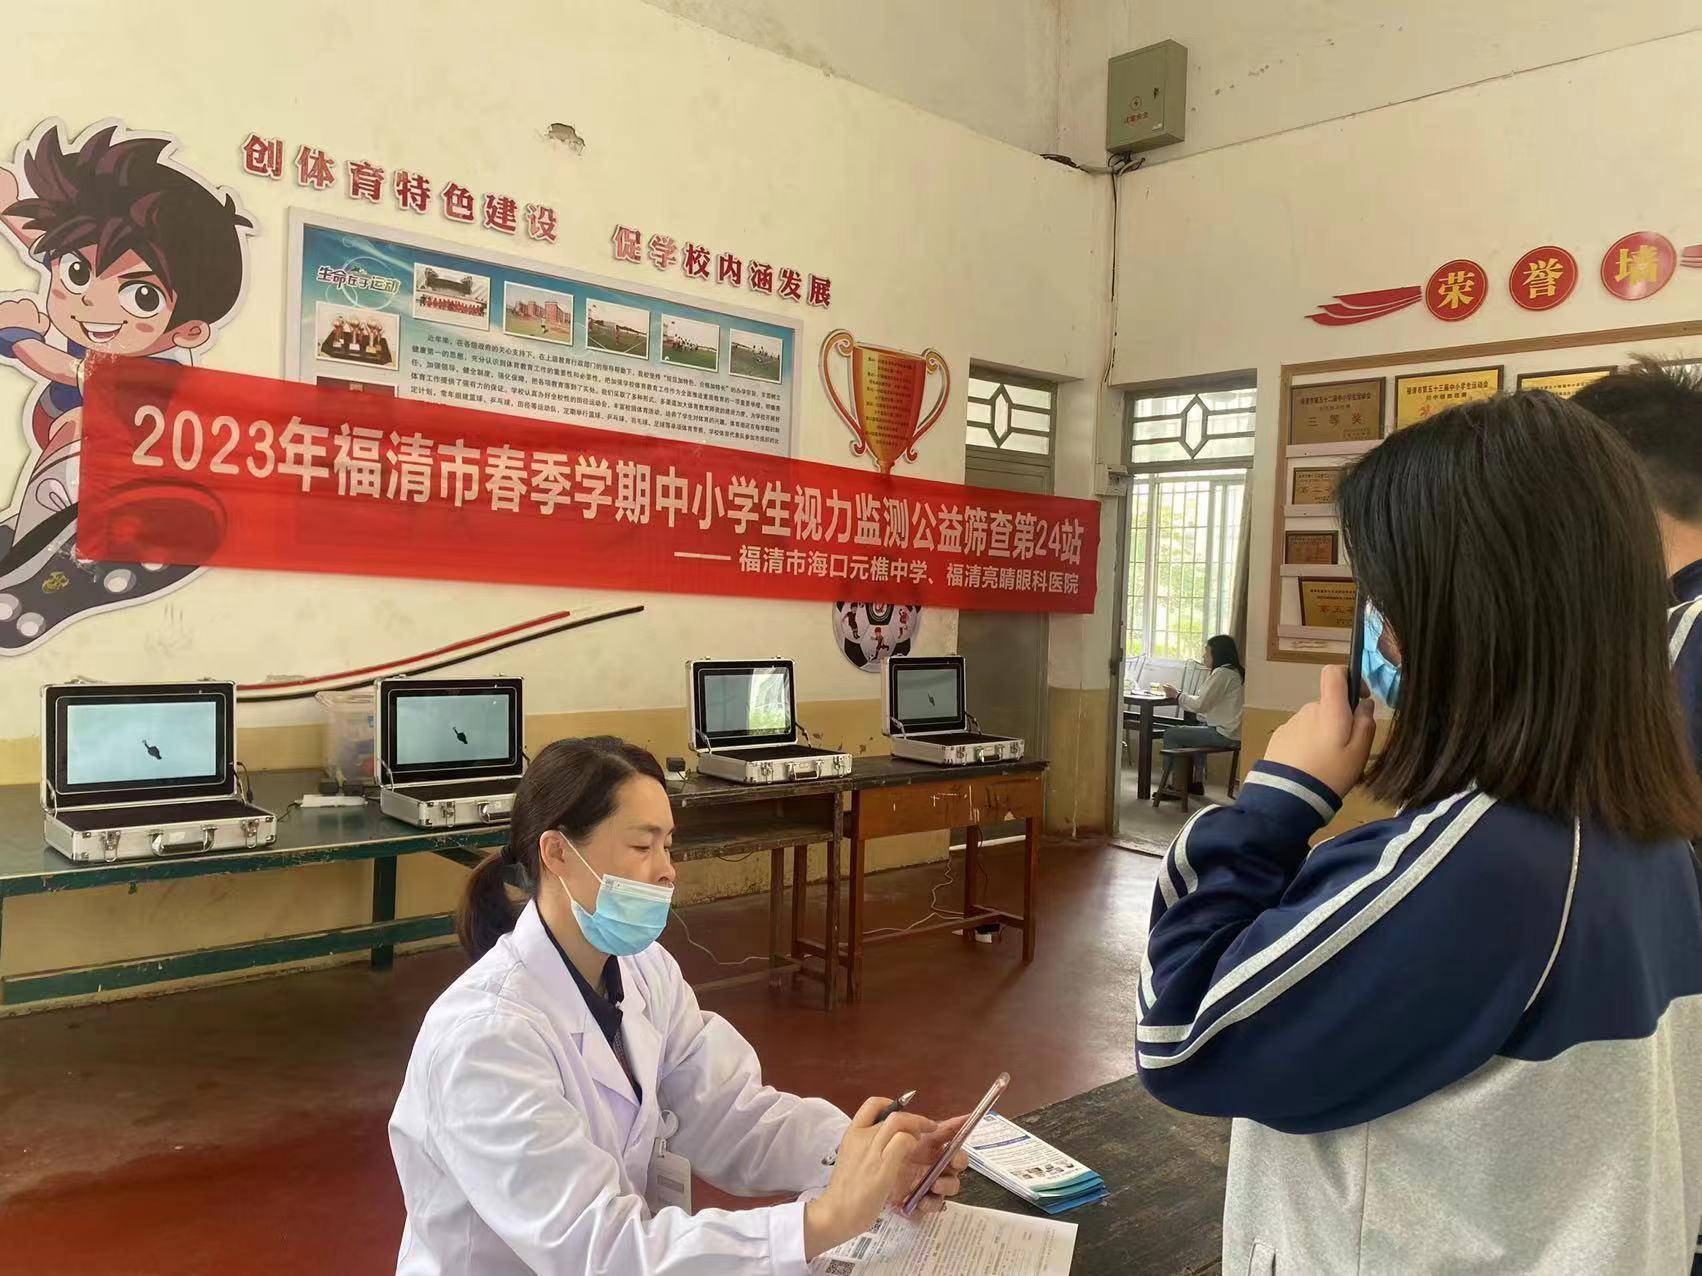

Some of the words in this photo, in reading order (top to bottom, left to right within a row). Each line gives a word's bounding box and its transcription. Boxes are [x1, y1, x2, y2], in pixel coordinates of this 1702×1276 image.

[242, 133, 559, 243] 创体育特色建设
[612, 225, 833, 307] 促学校内涵发展
[317, 267, 400, 293] 生命在于运动
[1307, 410, 1362, 428] 三等奖
[131, 404, 1085, 565] 2023年福清市春季学期中小学生视力监测公益筛查第24站
